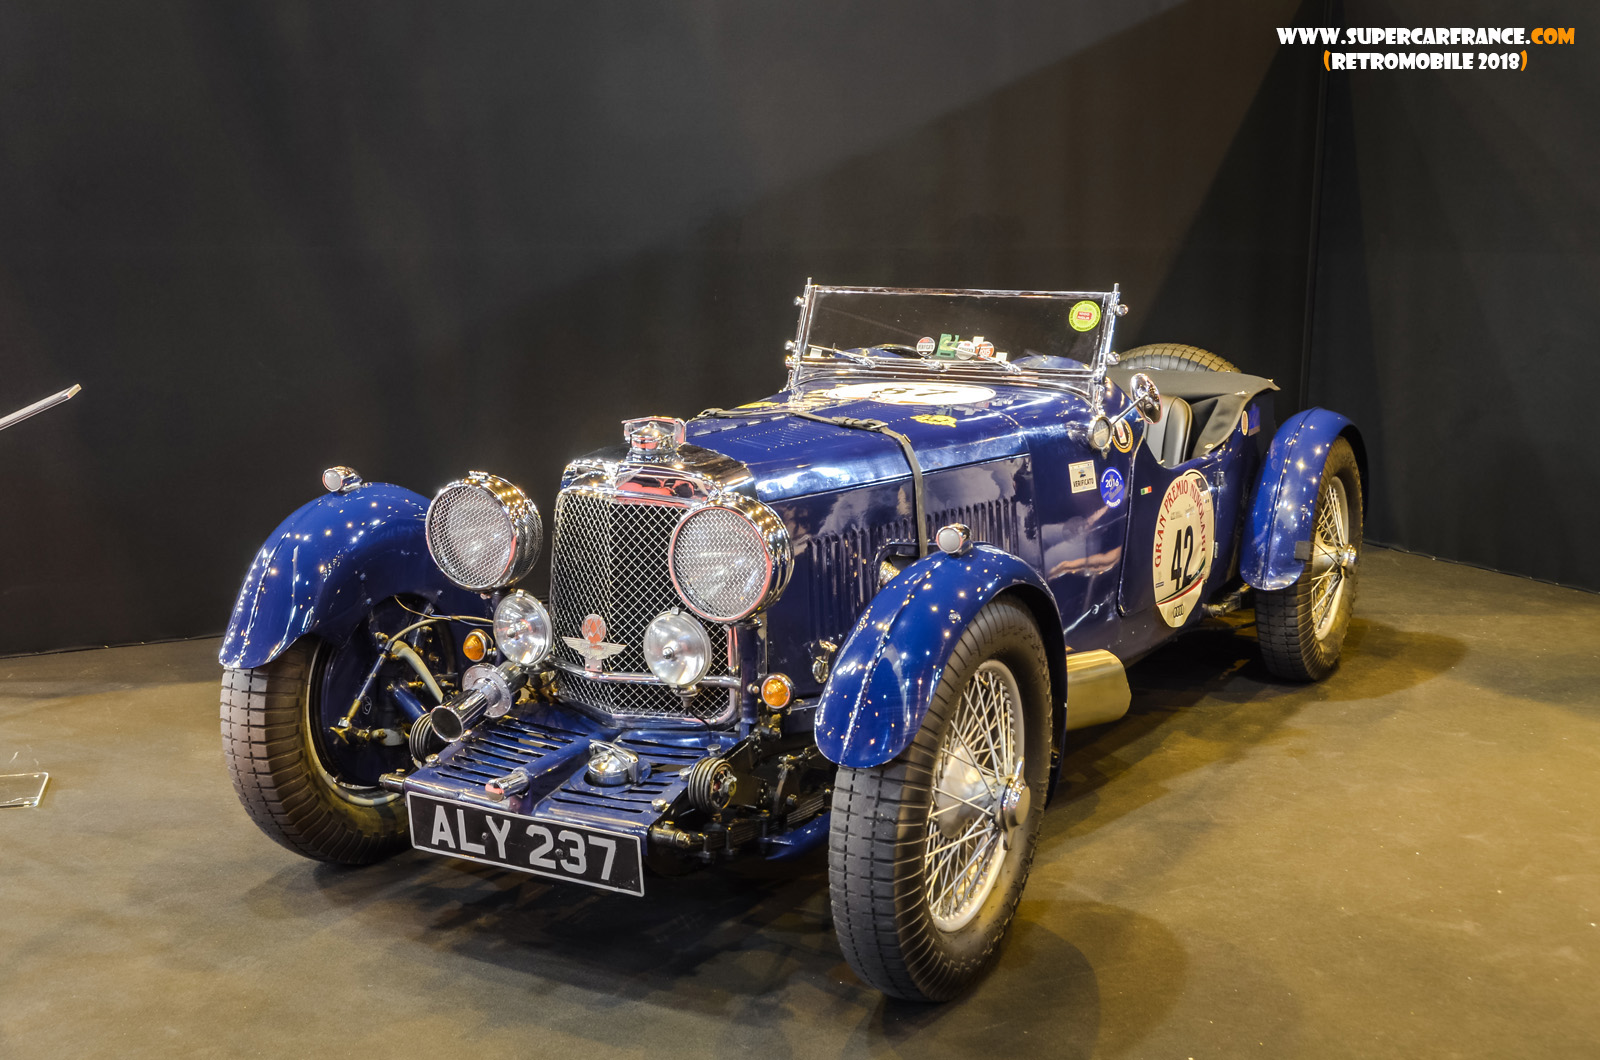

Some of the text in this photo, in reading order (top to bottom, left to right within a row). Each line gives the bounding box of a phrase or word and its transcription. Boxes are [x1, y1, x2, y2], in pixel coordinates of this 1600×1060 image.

[1072, 478, 1095, 488] VERIFICATO
[1154, 514, 1167, 568] GRAN
[1163, 479, 1189, 514] PREMIO
[1171, 525, 1194, 591] 42
[431, 805, 617, 881] ALY 237
